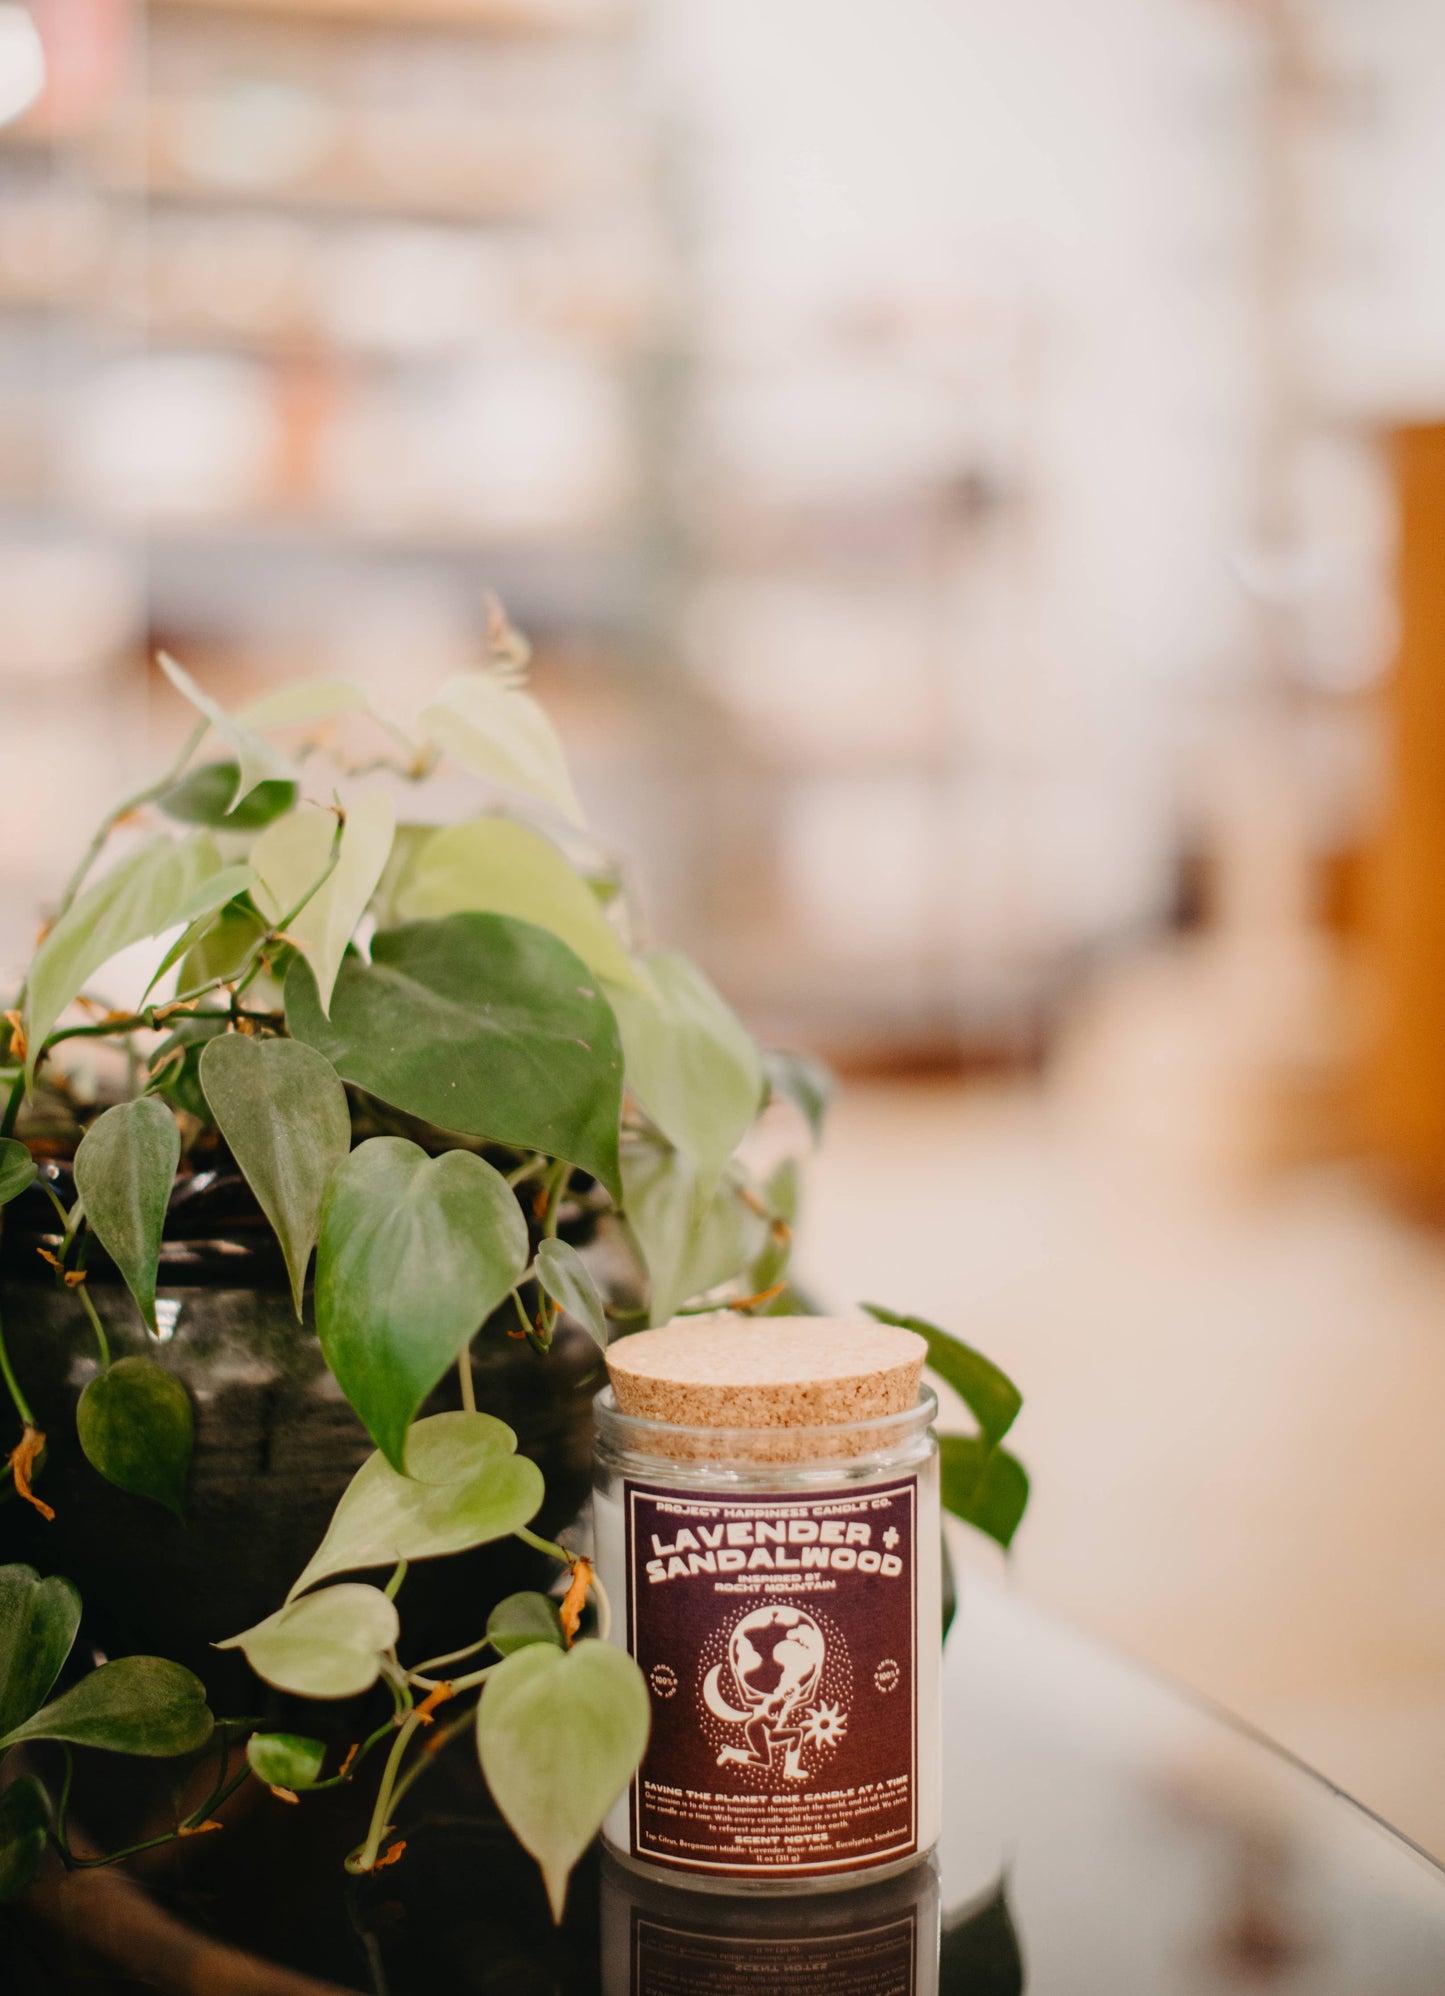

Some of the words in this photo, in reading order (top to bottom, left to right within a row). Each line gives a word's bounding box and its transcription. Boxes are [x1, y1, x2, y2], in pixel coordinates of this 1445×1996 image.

[656, 1502, 720, 1517] PROJECT
[723, 1508, 809, 1518] HAPPINESS
[812, 1501, 868, 1516] CANDLE
[871, 1497, 893, 1509] CO.
[650, 1520, 872, 1557] LAVENDER
[645, 1546, 903, 1584] SANDALWOOD
[737, 1574, 802, 1583] INSPIRED
[804, 1572, 821, 1581] BY
[764, 1580, 837, 1593] MOUNTAIN
[644, 1780, 682, 1797] SAVING
[685, 1789, 712, 1801] THE
[715, 1793, 768, 1803] PLANET
[771, 1794, 800, 1804] ONE
[803, 1787, 855, 1802] CANDLE
[857, 1784, 874, 1795] AT
[876, 1782, 884, 1791] A
[886, 1774, 908, 1788] TIME
[698, 1802, 725, 1811] elevate
[727, 1804, 766, 1814] happiness
[767, 1804, 810, 1814] throughout
[812, 1802, 825, 1811] the
[848, 1796, 862, 1806] and
[714, 1813, 732, 1822] With
[734, 1816, 755, 1824] every
[757, 1815, 783, 1824] candle
[784, 1815, 801, 1824] sold
[802, 1813, 823, 1822] there
[823, 1812, 831, 1820] is
[839, 1810, 853, 1818] tree
[709, 1823, 718, 1832] to
[719, 1824, 749, 1833] reforest
[750, 1825, 766, 1834] and
[767, 1824, 813, 1834] rehabilitate
[814, 1822, 827, 1831] the
[734, 1835, 781, 1845] SCENT
[783, 1832, 829, 1845] NOTES
[748, 1845, 785, 1854] Lavender
